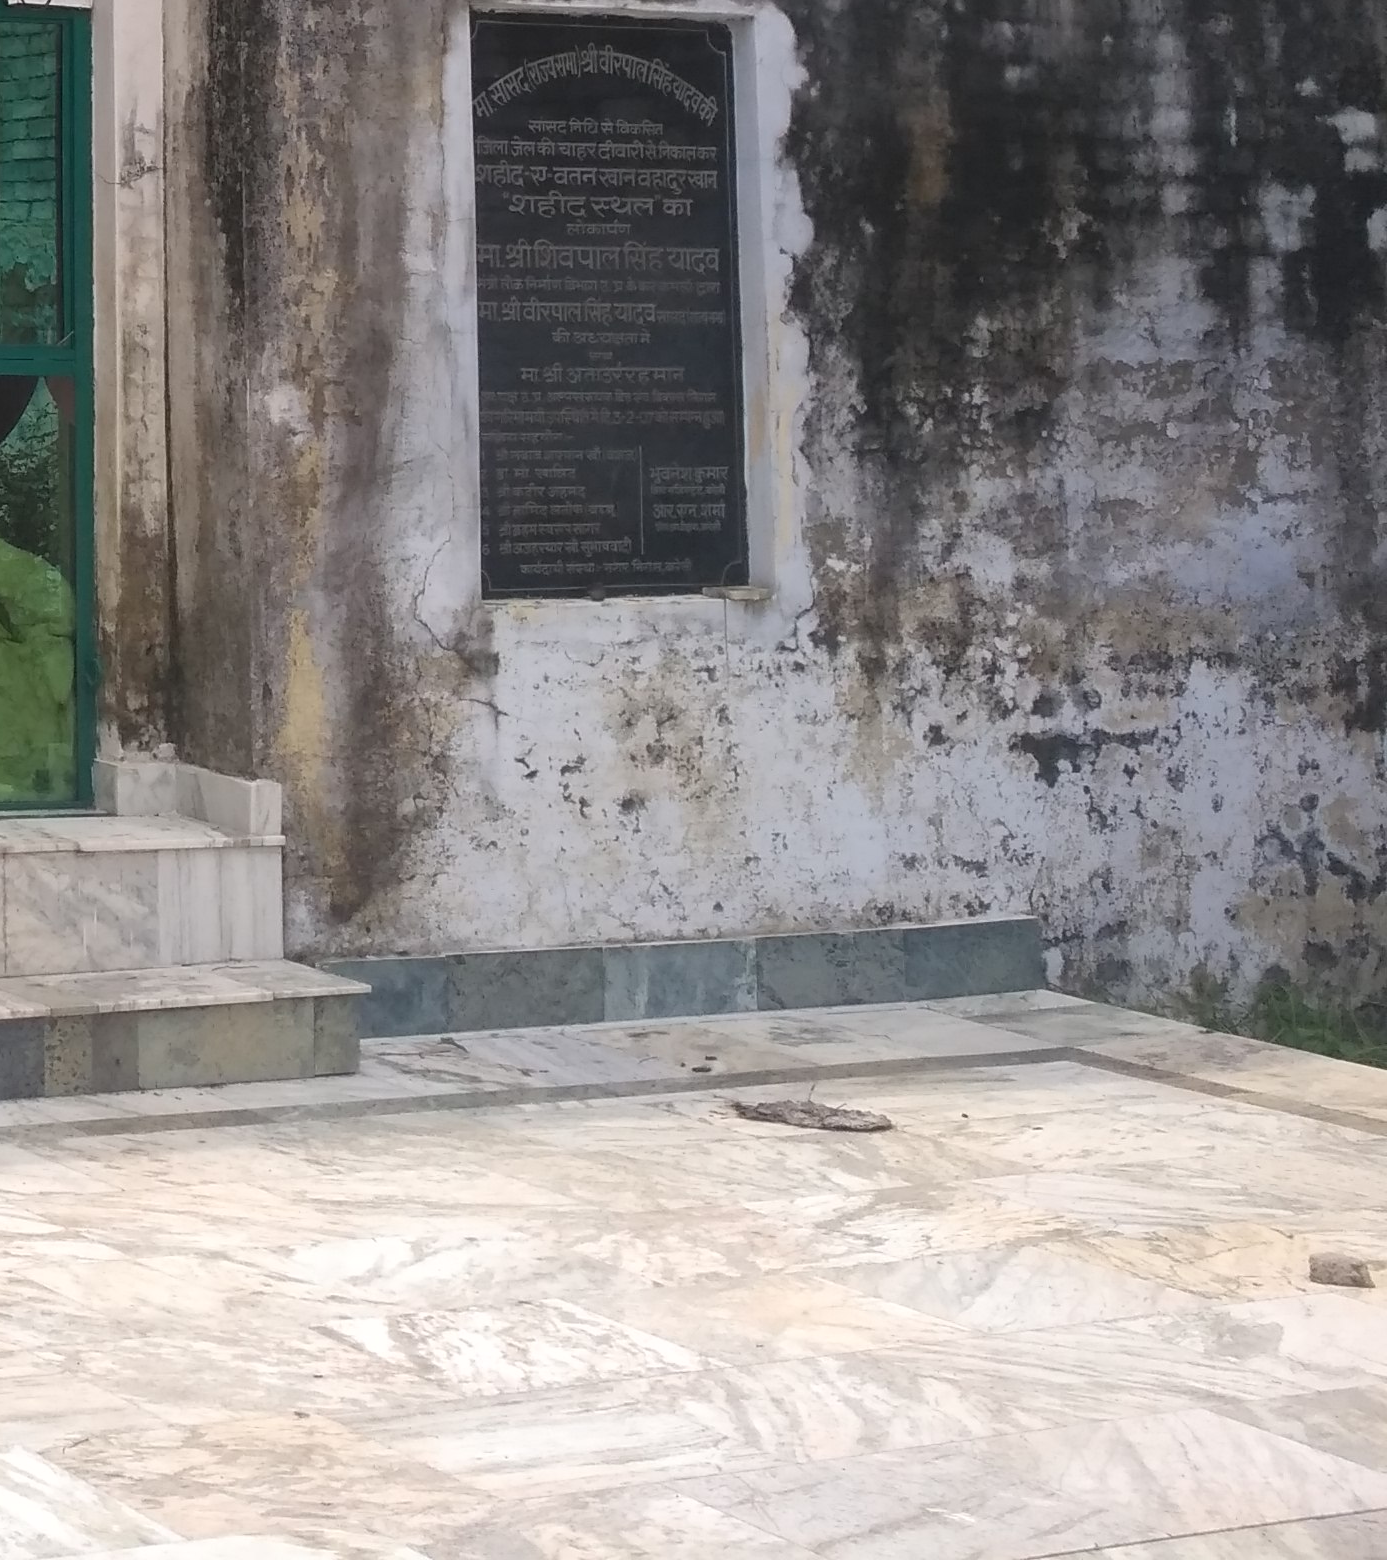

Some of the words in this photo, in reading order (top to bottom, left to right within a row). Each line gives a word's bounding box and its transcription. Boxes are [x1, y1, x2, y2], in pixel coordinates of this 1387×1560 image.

[662, 198, 694, 217] का
[505, 238, 533, 269] श्री
[666, 247, 720, 276] यादव
